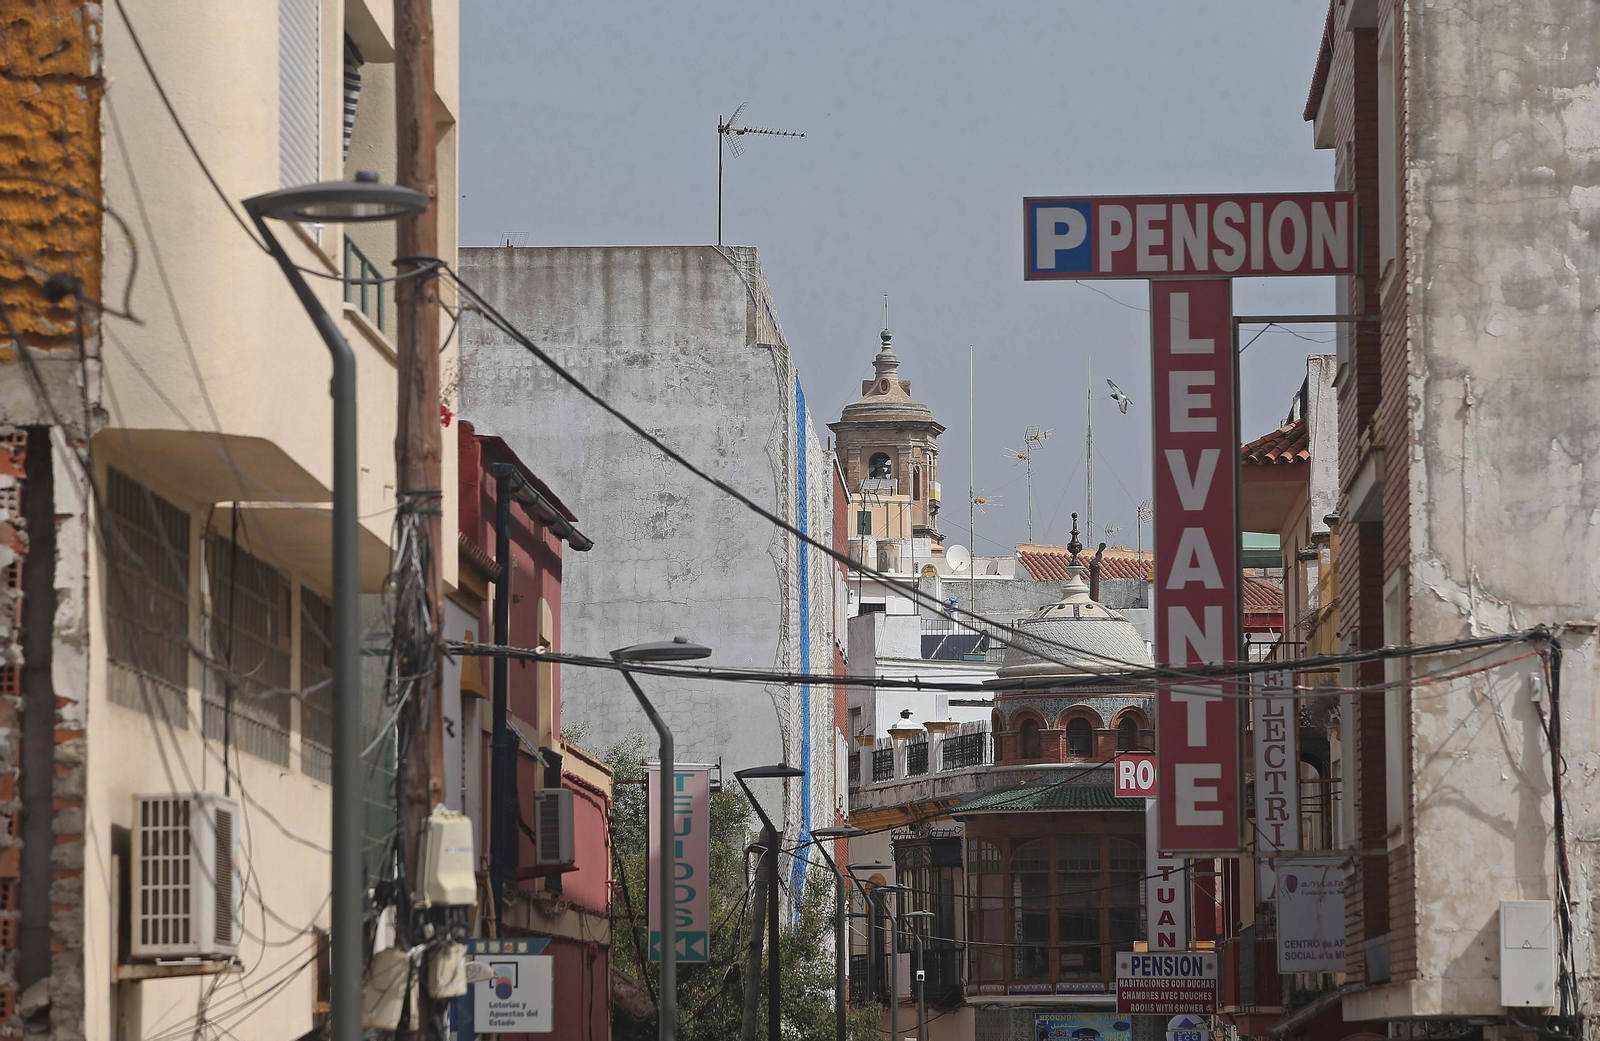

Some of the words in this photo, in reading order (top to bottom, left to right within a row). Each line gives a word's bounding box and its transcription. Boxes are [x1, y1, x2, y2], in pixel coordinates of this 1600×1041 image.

[1036, 206, 1088, 269] P
[1098, 200, 1348, 273] PENSION
[1164, 292, 1225, 827] LEVANTE
[1119, 759, 1157, 790] RO
[1260, 669, 1290, 899] ELECTRI
[1284, 939, 1320, 949] CENTRO
[1334, 939, 1346, 948] AP
[1284, 951, 1317, 960] SOCIAL
[1131, 956, 1203, 977] PENSION
[1119, 979, 1170, 988] HABITACIONES
[1171, 980, 1185, 988] CON
[1187, 980, 1215, 988] DUCHAS
[1122, 991, 1159, 1000] CHAMBRES
[1160, 991, 1178, 1000] AVEC
[1179, 992, 1212, 1001] DOUCHES
[521, 1002, 527, 1010] y
[1130, 1003, 1155, 1012] ROOMS
[1155, 1003, 1174, 1012] WITH
[1174, 1004, 1204, 1013] SHOWER
[489, 1010, 525, 1019] Apuestas
[526, 1009, 538, 1017] del
